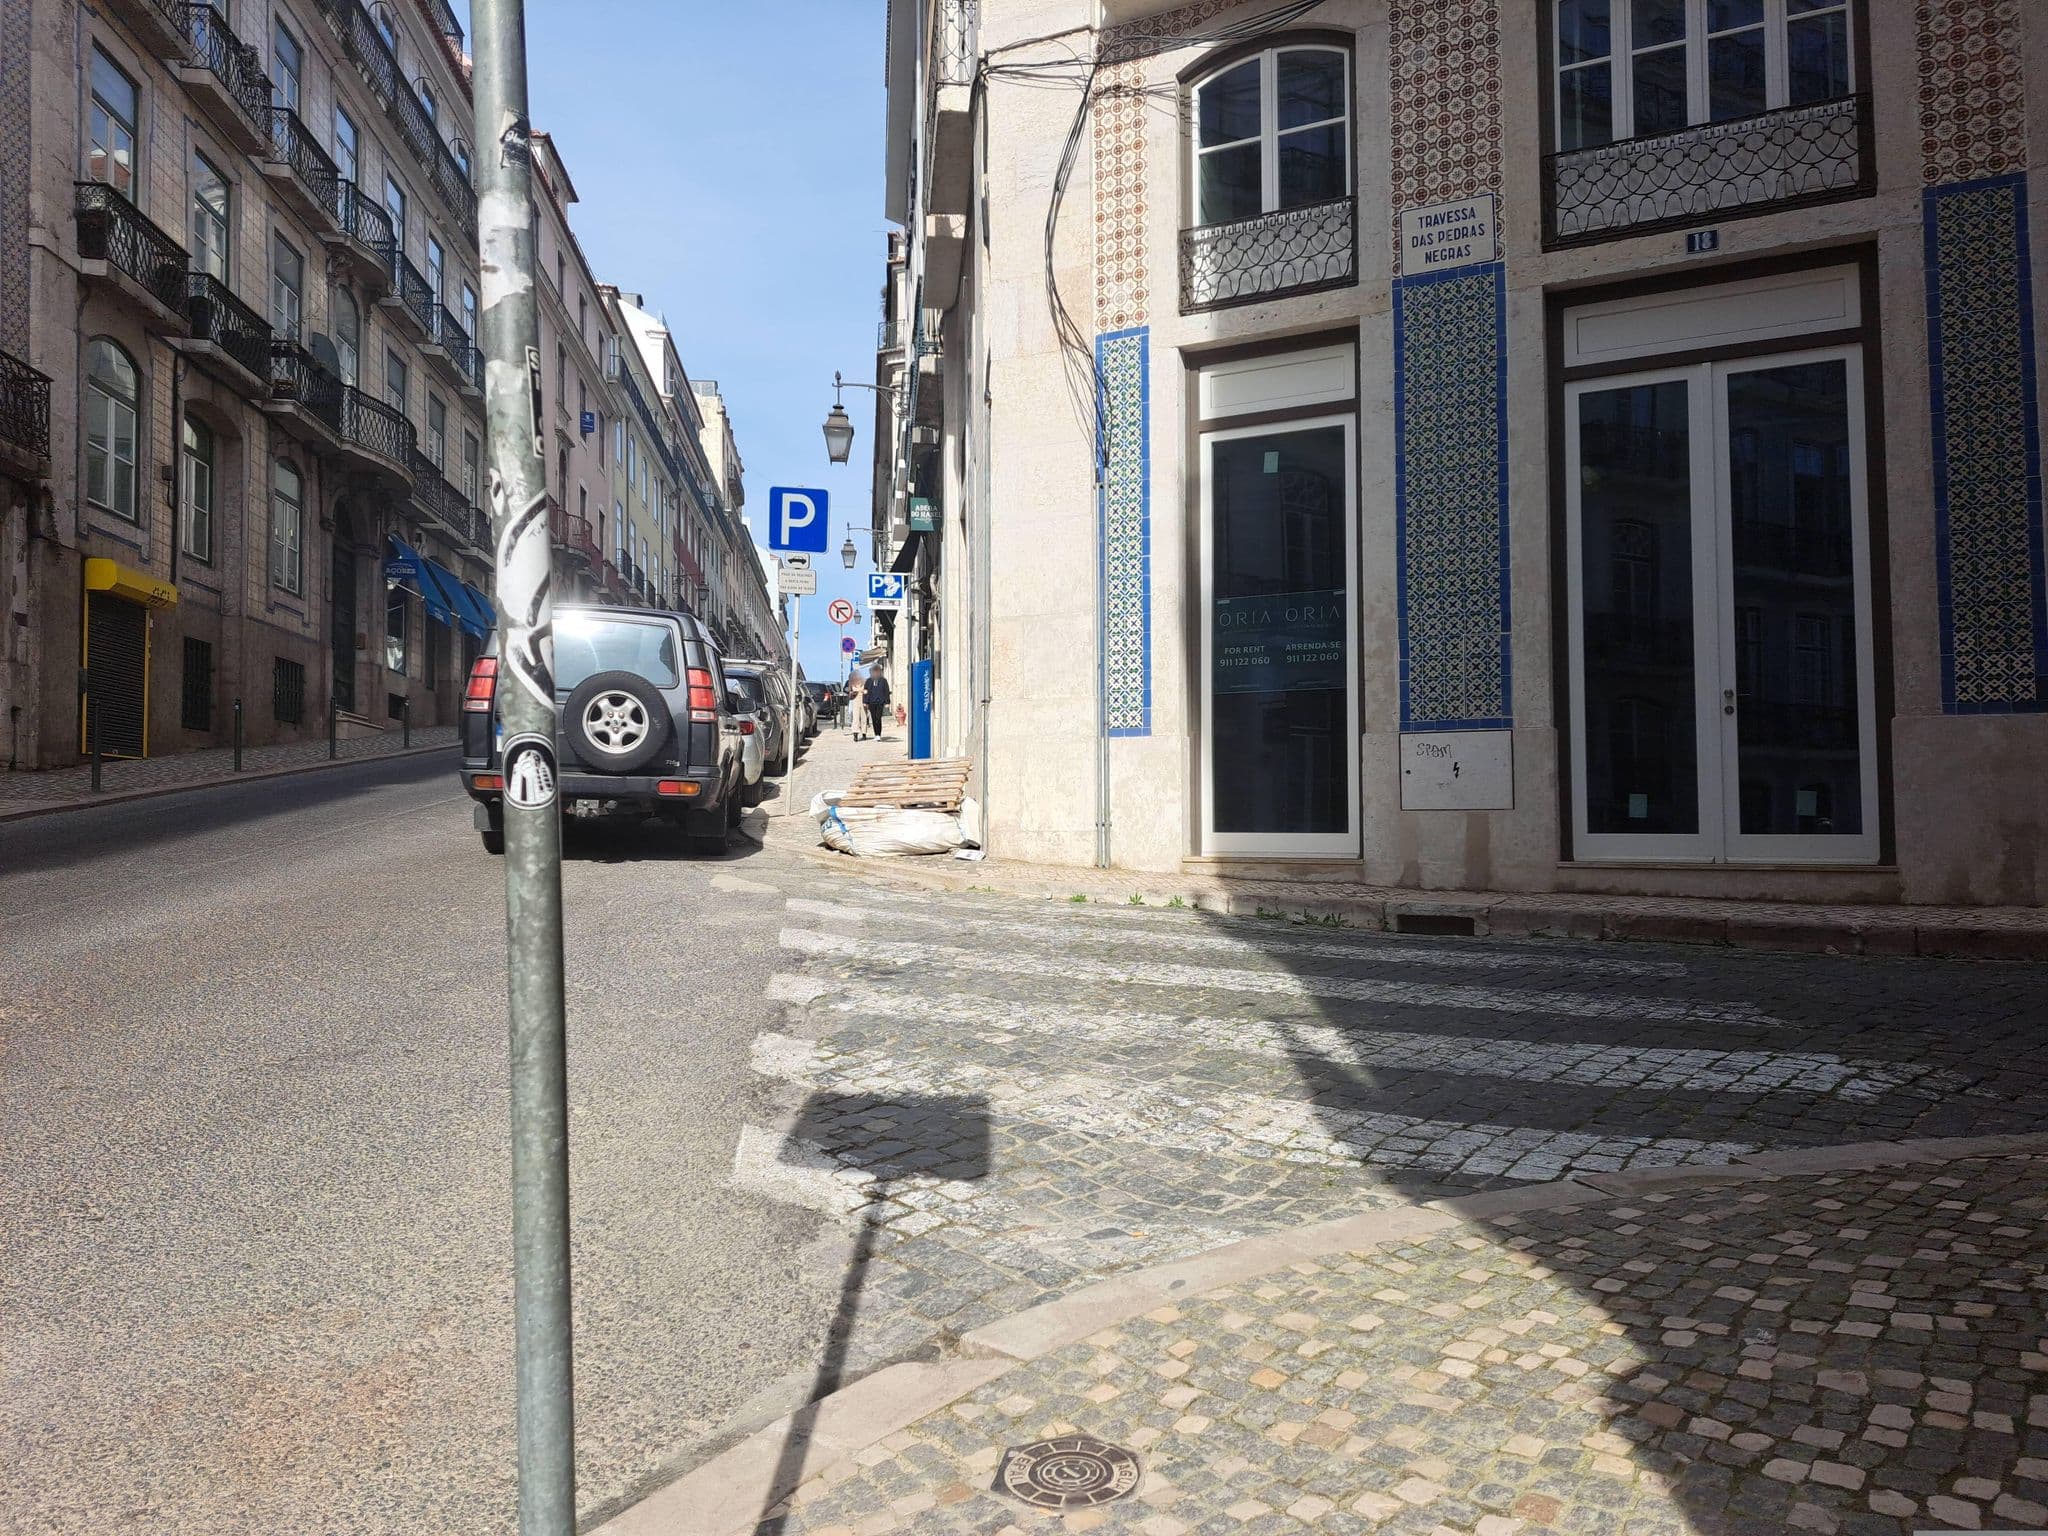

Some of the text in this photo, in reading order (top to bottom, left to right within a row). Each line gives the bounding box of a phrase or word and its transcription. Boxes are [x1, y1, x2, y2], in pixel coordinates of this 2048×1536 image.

[1418, 207, 1476, 229] TRAVESSA
[1412, 223, 1485, 248] DAS PEDRAS
[1425, 244, 1471, 264] NEGRAS
[781, 493, 816, 546] P
[871, 576, 884, 593] P
[1219, 610, 1272, 627] ORIA
[1285, 605, 1340, 622] ORIA
[1224, 645, 1265, 655] FOR RENT
[1285, 640, 1341, 651] ARRENDA-SE
[1220, 656, 1270, 667] 911 122 060
[1286, 652, 1340, 663] 911 122 060
